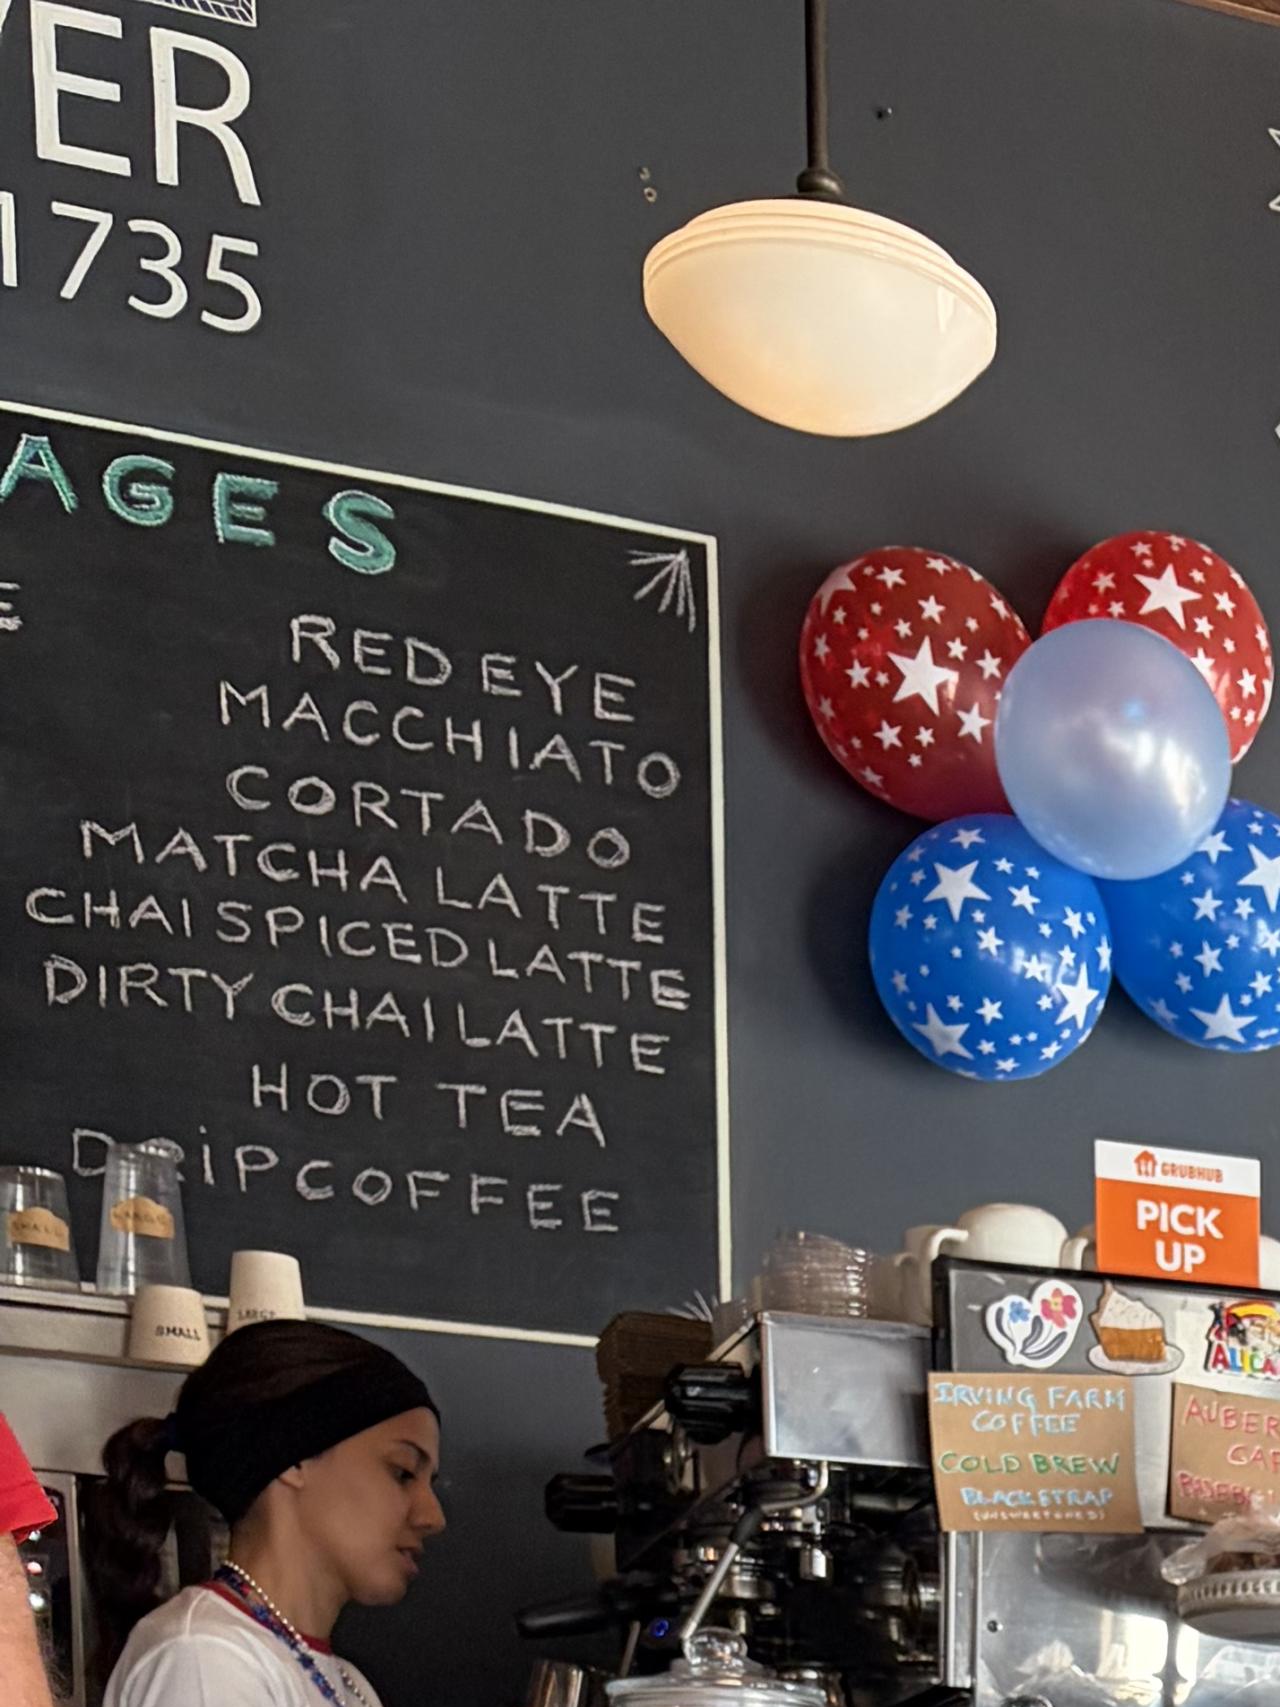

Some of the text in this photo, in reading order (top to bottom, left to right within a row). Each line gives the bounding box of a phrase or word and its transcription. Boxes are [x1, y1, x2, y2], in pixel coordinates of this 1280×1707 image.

[0, 0, 262, 207] ER
[290, 613, 636, 723] RED EYE
[218, 680, 681, 798] MACCHIATO
[225, 765, 630, 869] CORTADO
[80, 820, 667, 945] MATCHA LATTE
[25, 886, 692, 1011] CHAI SPICED LATTE
[44, 953, 671, 1076] DIRTY CHAI LATTE
[251, 1062, 607, 1148] HOT TEA
[296, 1159, 620, 1232] COFFEE
[1161, 1161, 1224, 1183] GRUBHUB
[1136, 1199, 1224, 1240] PICK
[1155, 1240, 1207, 1274] UP
[155, 1325, 202, 1341] SMALL
[934, 1382, 1126, 1411] IRVING FARM
[971, 1410, 1081, 1436] COFFEE
[939, 1450, 1120, 1476] COLD BREW
